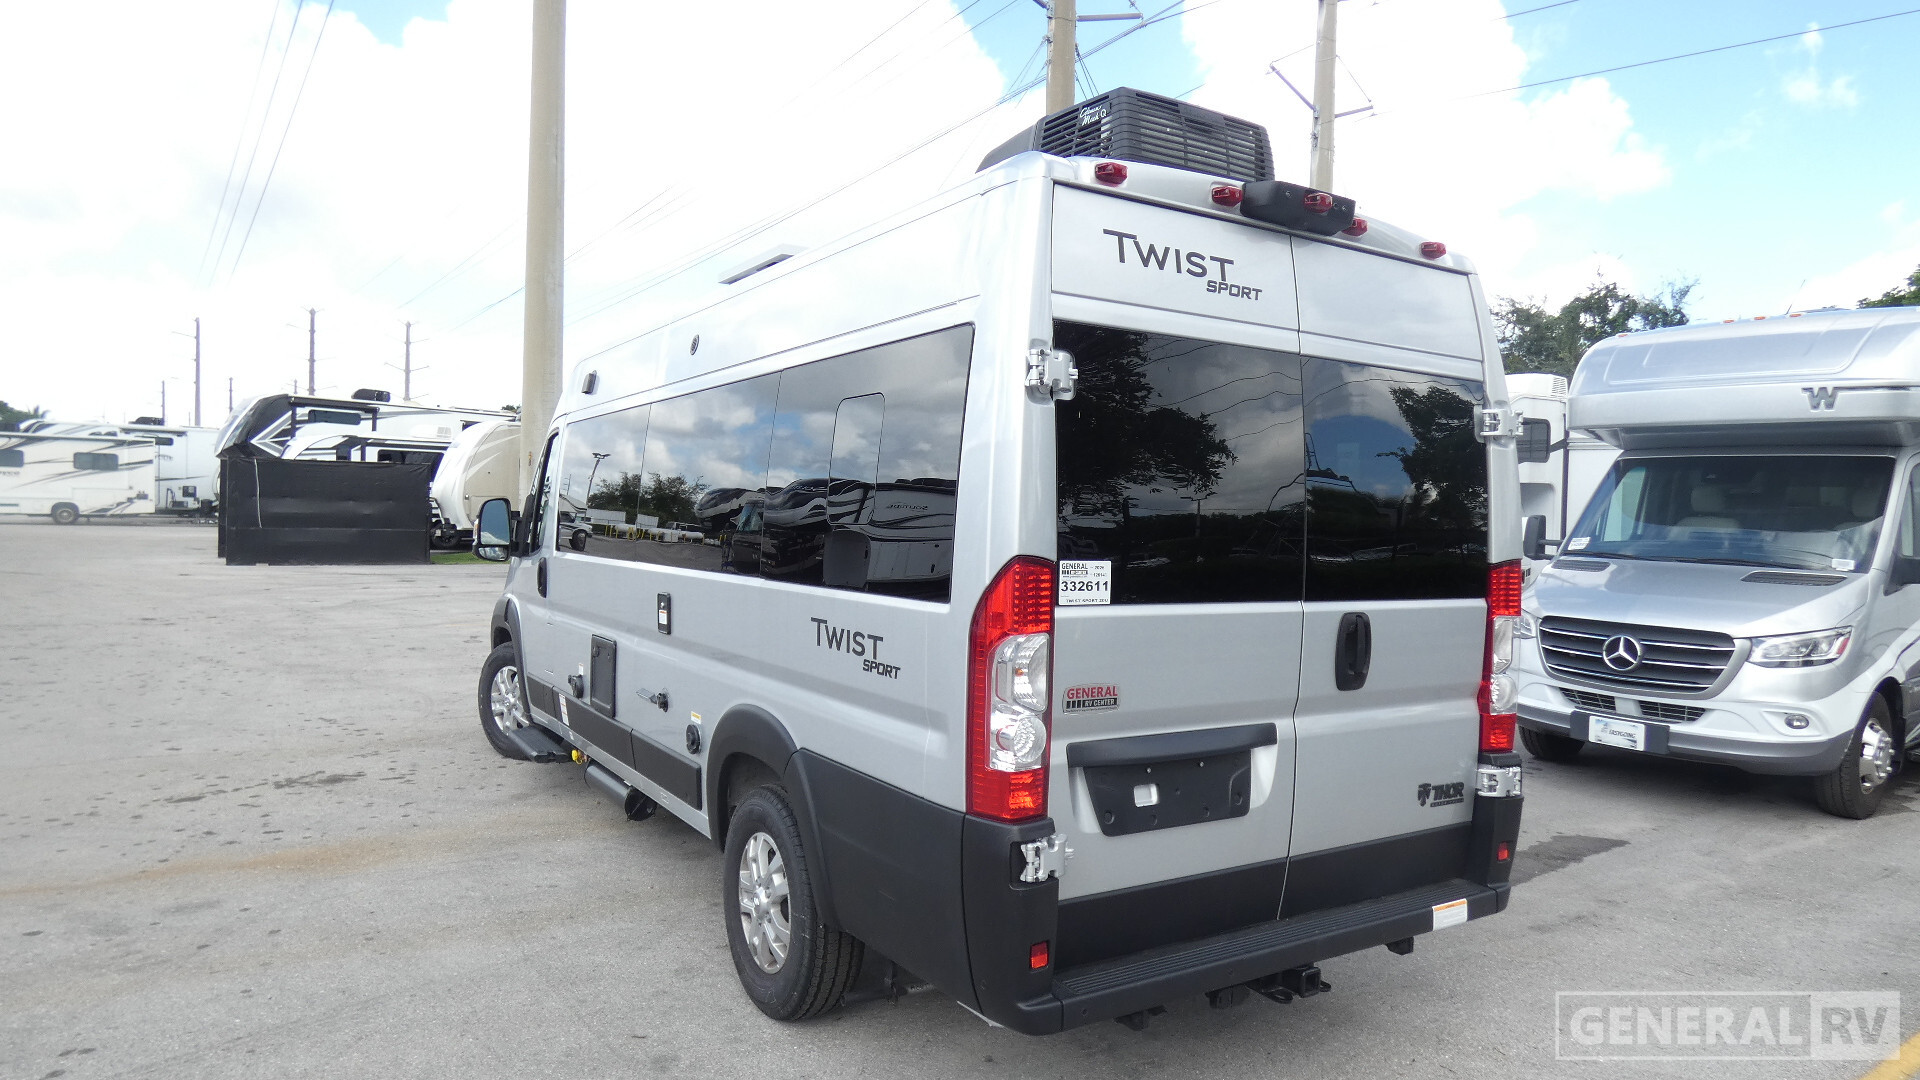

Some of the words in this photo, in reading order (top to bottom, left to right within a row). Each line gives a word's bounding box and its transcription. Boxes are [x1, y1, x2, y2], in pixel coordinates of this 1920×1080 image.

[1206, 280, 1263, 301] SPORT
[1061, 562, 1089, 570] GENERAL
[1060, 580, 1109, 592] 332611
[862, 658, 901, 680] SPORT
[1066, 685, 1118, 700] GENERAL
[1093, 698, 1115, 706] CENTER
